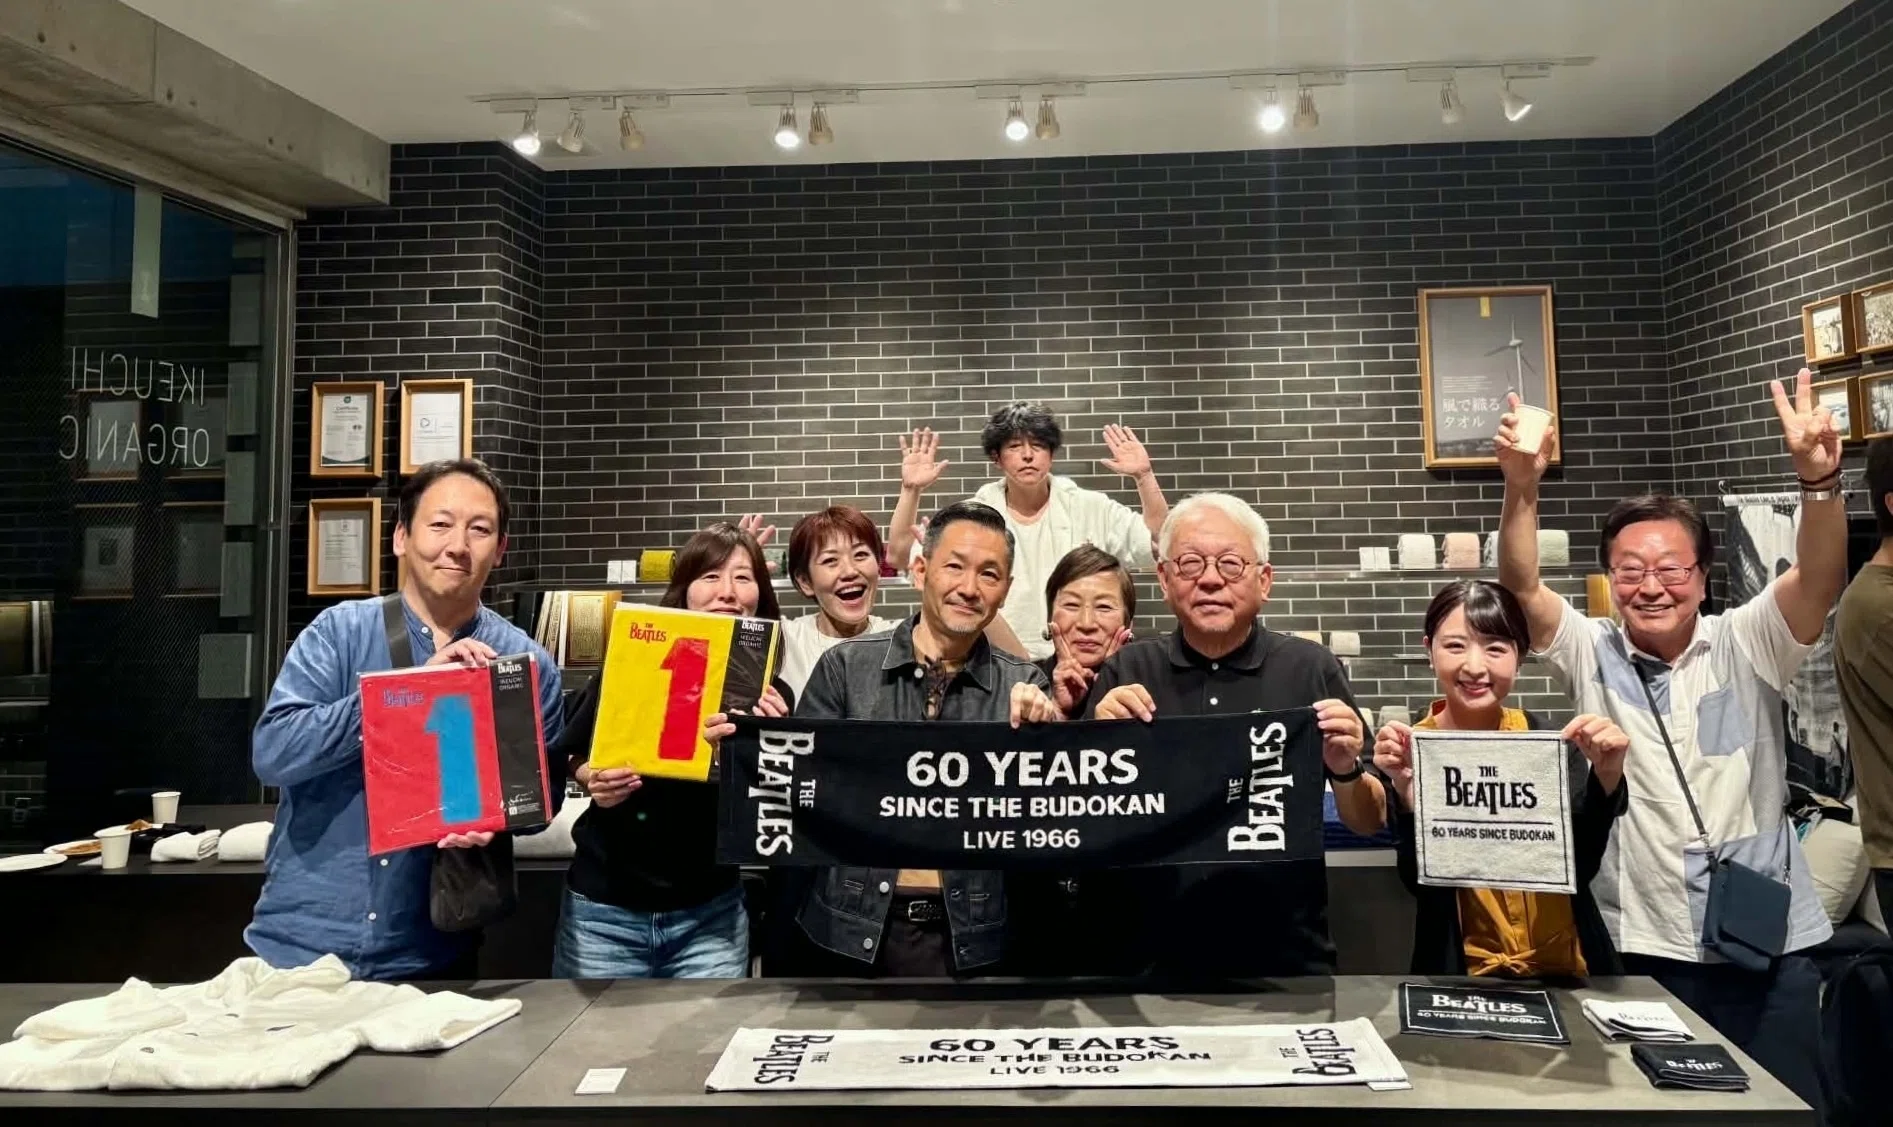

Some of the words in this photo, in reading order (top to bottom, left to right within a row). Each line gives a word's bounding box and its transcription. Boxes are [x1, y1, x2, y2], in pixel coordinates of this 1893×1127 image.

[1442, 397, 1500, 412] 風で織る
[1444, 416, 1485, 428] タオル
[630, 622, 667, 643] BEATLES
[657, 637, 710, 761] 1
[424, 693, 482, 824] 1
[907, 751, 969, 787] 60
[984, 749, 1139, 787] YEARS
[1478, 766, 1498, 777] THE
[749, 729, 815, 856] BEATLES
[800, 779, 816, 808] THE
[1227, 722, 1293, 852] BEATLES
[1227, 777, 1243, 803] THE
[1443, 766, 1537, 814] BEATLES
[880, 796, 959, 818] SINCE
[968, 797, 1021, 818] THE
[1030, 793, 1165, 818] BUDOKAN
[963, 830, 1014, 849] LIVE
[1022, 828, 1081, 848] 1966
[1432, 827, 1445, 838] 60
[1447, 827, 1477, 839] YEARS
[1479, 828, 1508, 840] SINCE
[1509, 829, 1555, 841] BUDOKAN
[1432, 994, 1527, 1013] BEATLES
[930, 1039, 995, 1051] 60
[1013, 1037, 1180, 1050] YEARS
[753, 1035, 834, 1084] BEATLES
[811, 1051, 830, 1063] THE
[898, 1054, 985, 1063] SINCE
[995, 1053, 1052, 1063] THE
[1062, 1051, 1211, 1063] BUDOKAN
[990, 1065, 1046, 1074] LIVE
[1058, 1065, 1120, 1074] 1966
